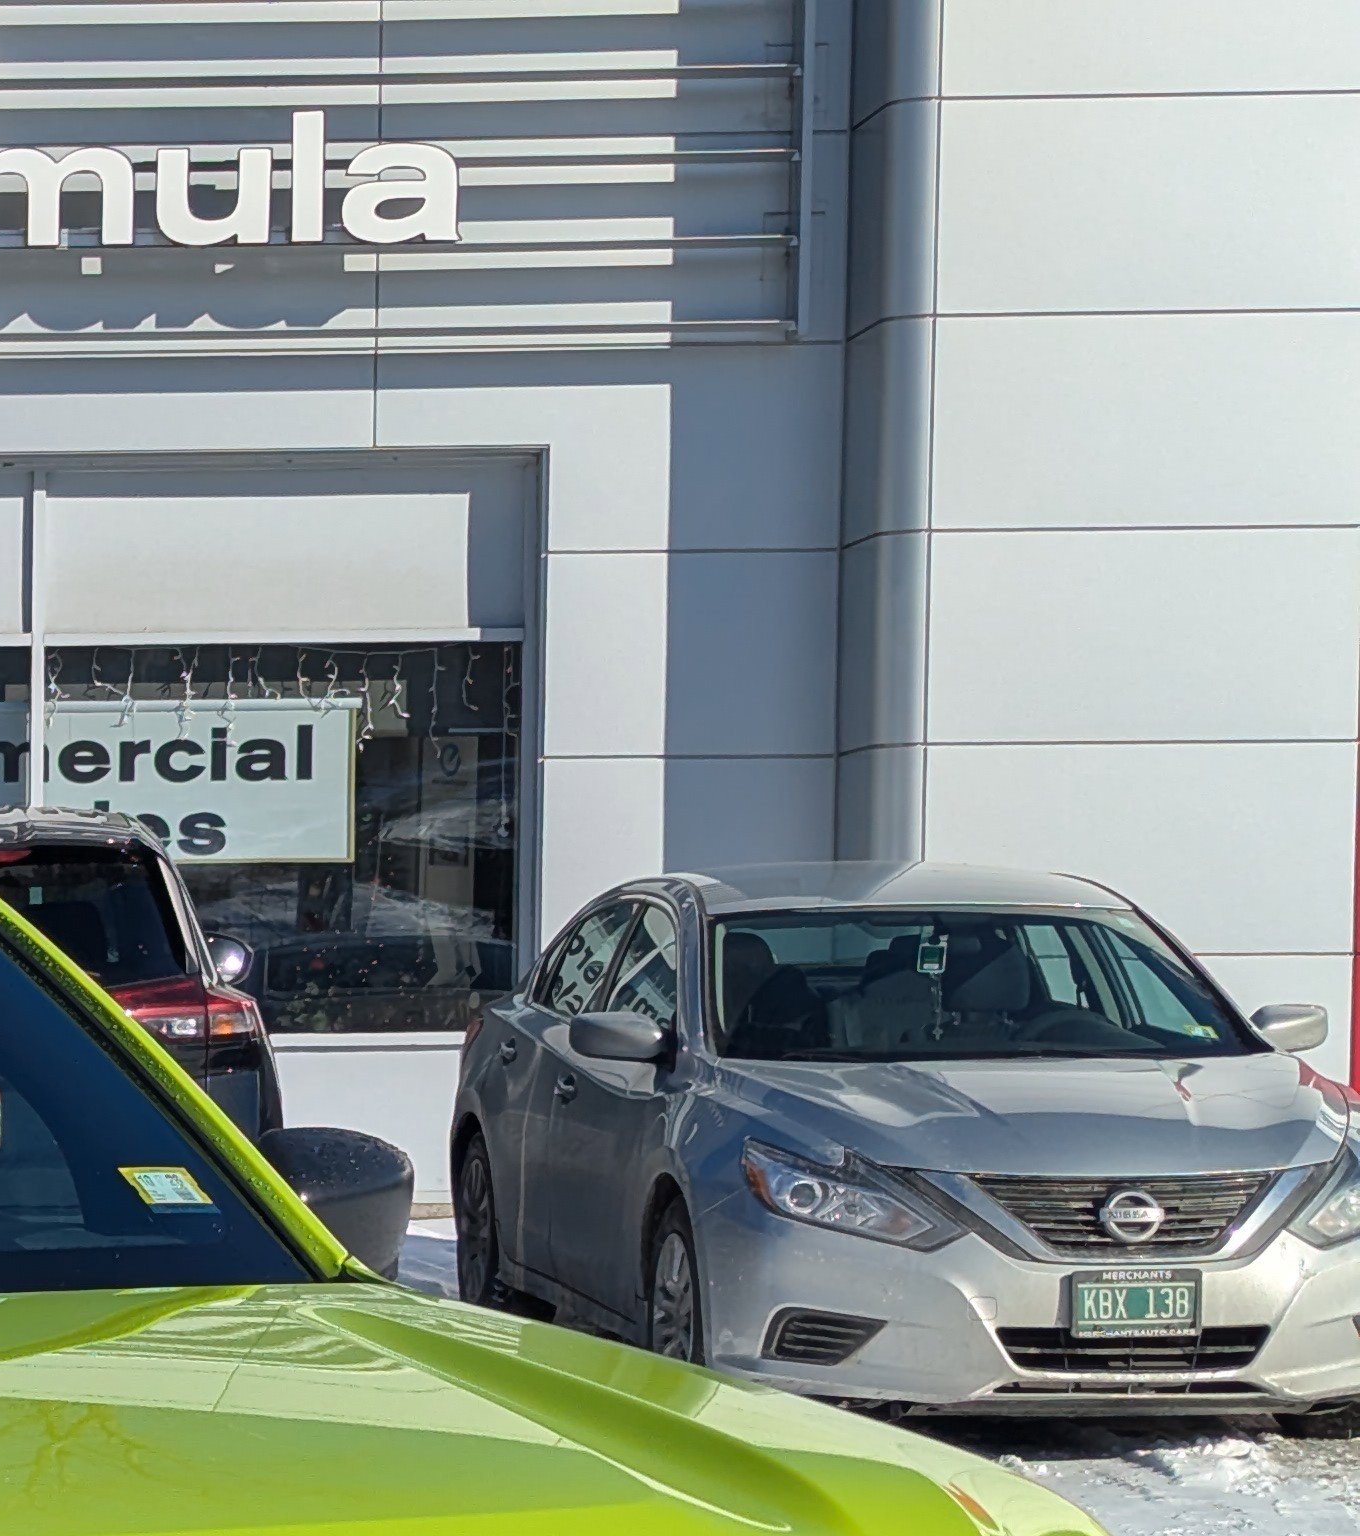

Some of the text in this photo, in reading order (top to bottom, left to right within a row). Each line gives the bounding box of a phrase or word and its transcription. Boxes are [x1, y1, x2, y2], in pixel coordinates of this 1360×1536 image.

[1107, 1209, 1160, 1219] NISSA
[1102, 1270, 1172, 1280] MERCHANTS
[1083, 1287, 1189, 1320] KBX 138
